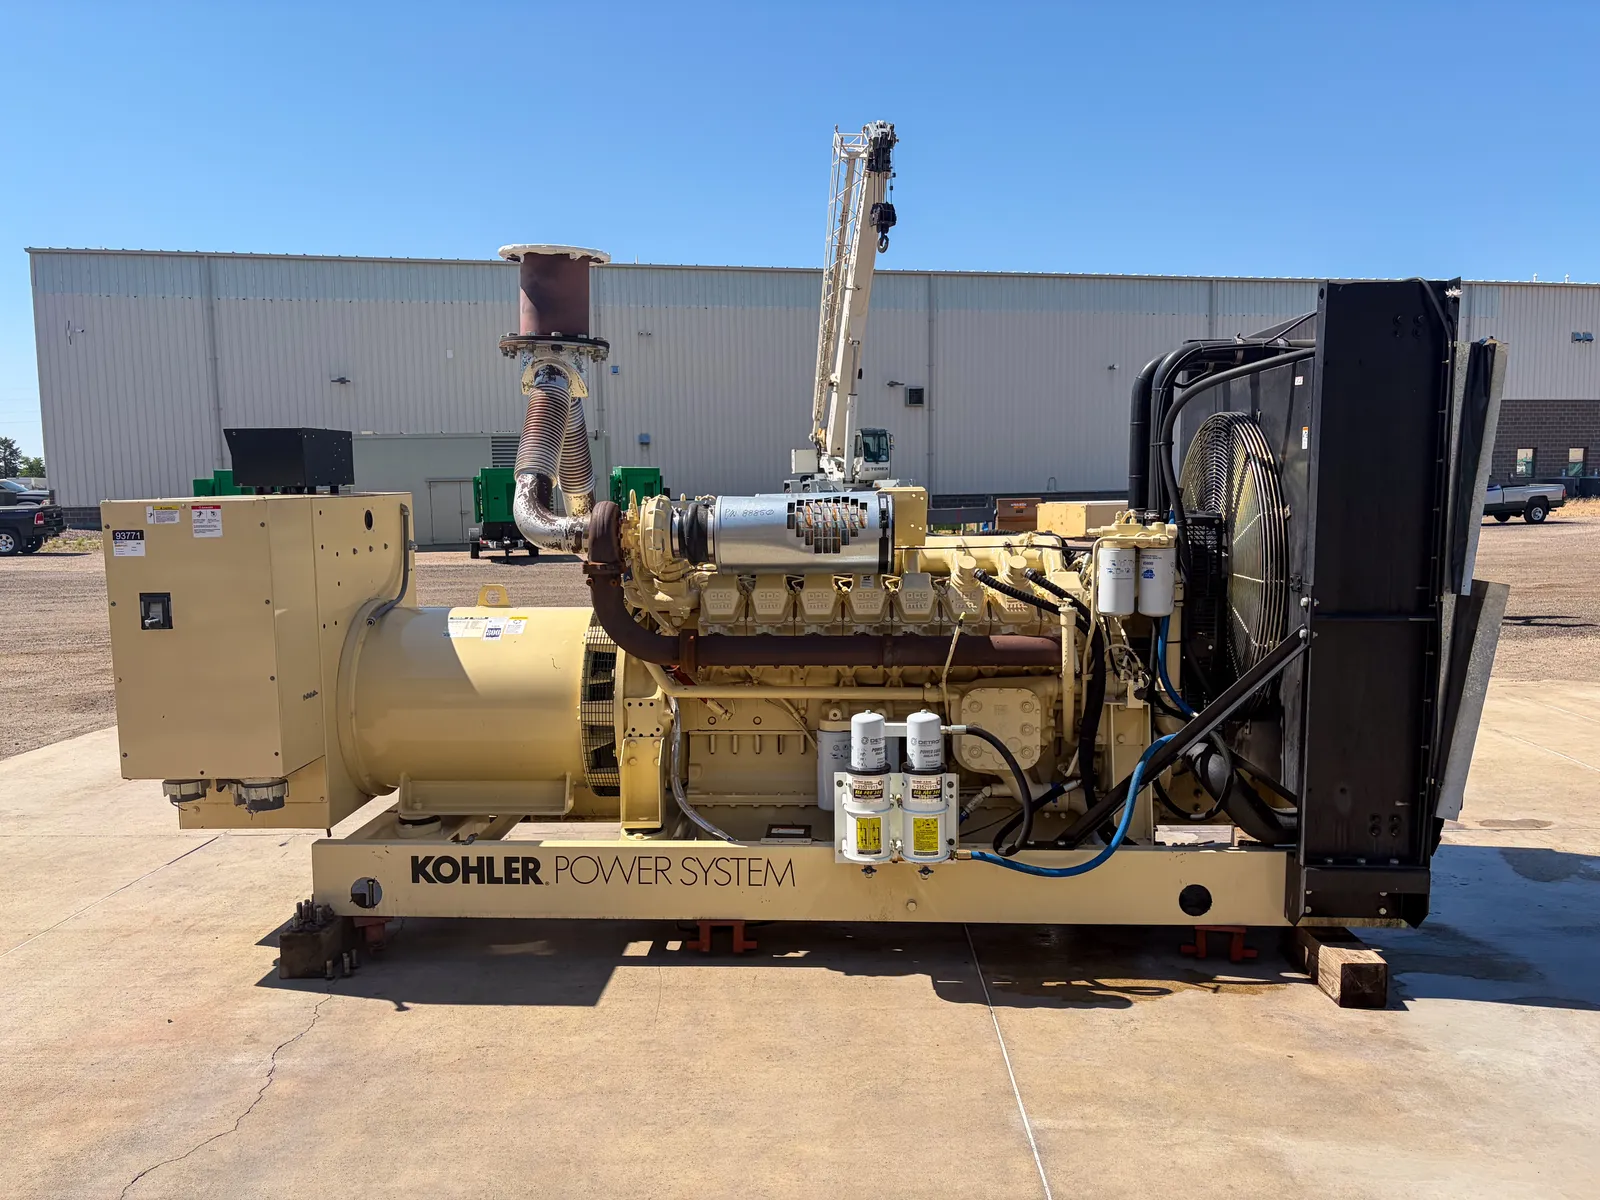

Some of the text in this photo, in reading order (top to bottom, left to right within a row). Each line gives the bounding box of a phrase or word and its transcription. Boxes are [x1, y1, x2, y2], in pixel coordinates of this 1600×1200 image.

[115, 531, 141, 540] 93771
[411, 855, 796, 887] KOHLER POWER SYSTEM
